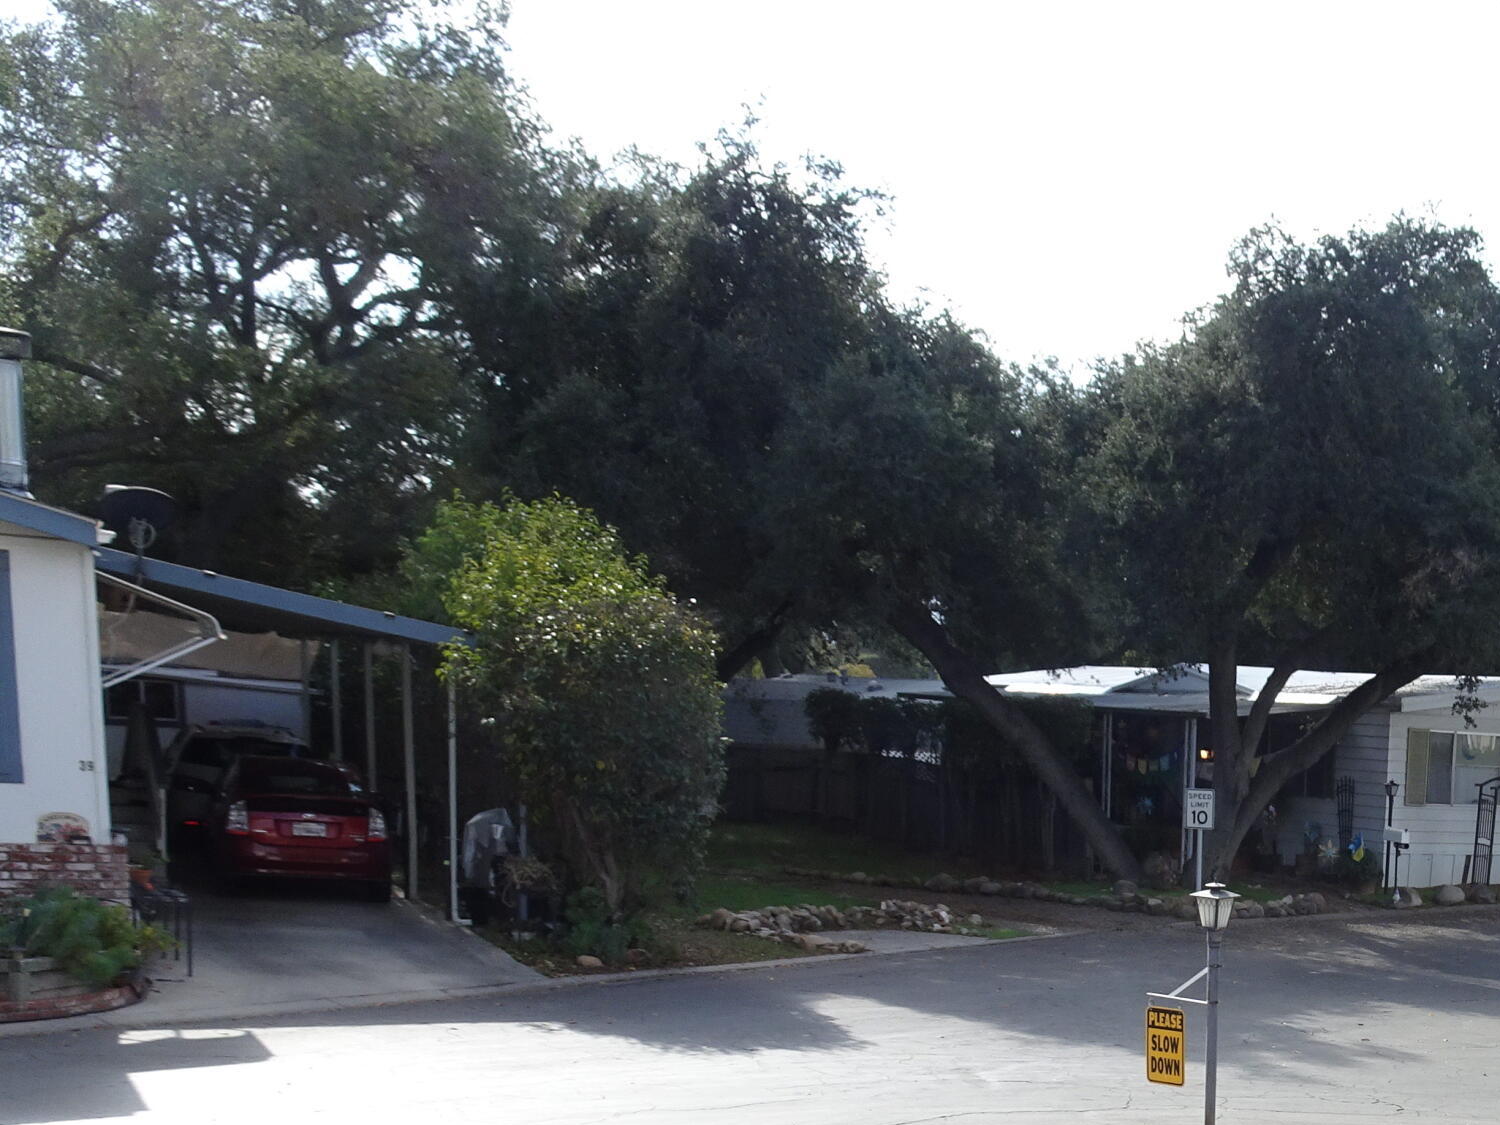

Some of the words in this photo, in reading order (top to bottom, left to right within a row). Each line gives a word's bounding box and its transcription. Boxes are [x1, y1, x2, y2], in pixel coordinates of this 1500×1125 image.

[1188, 792, 1212, 800] SPEED
[1191, 810, 1208, 824] 10
[1148, 1011, 1183, 1029] PLEASE
[1151, 1033, 1180, 1054] SLOW
[1151, 1055, 1180, 1077] DOWN
